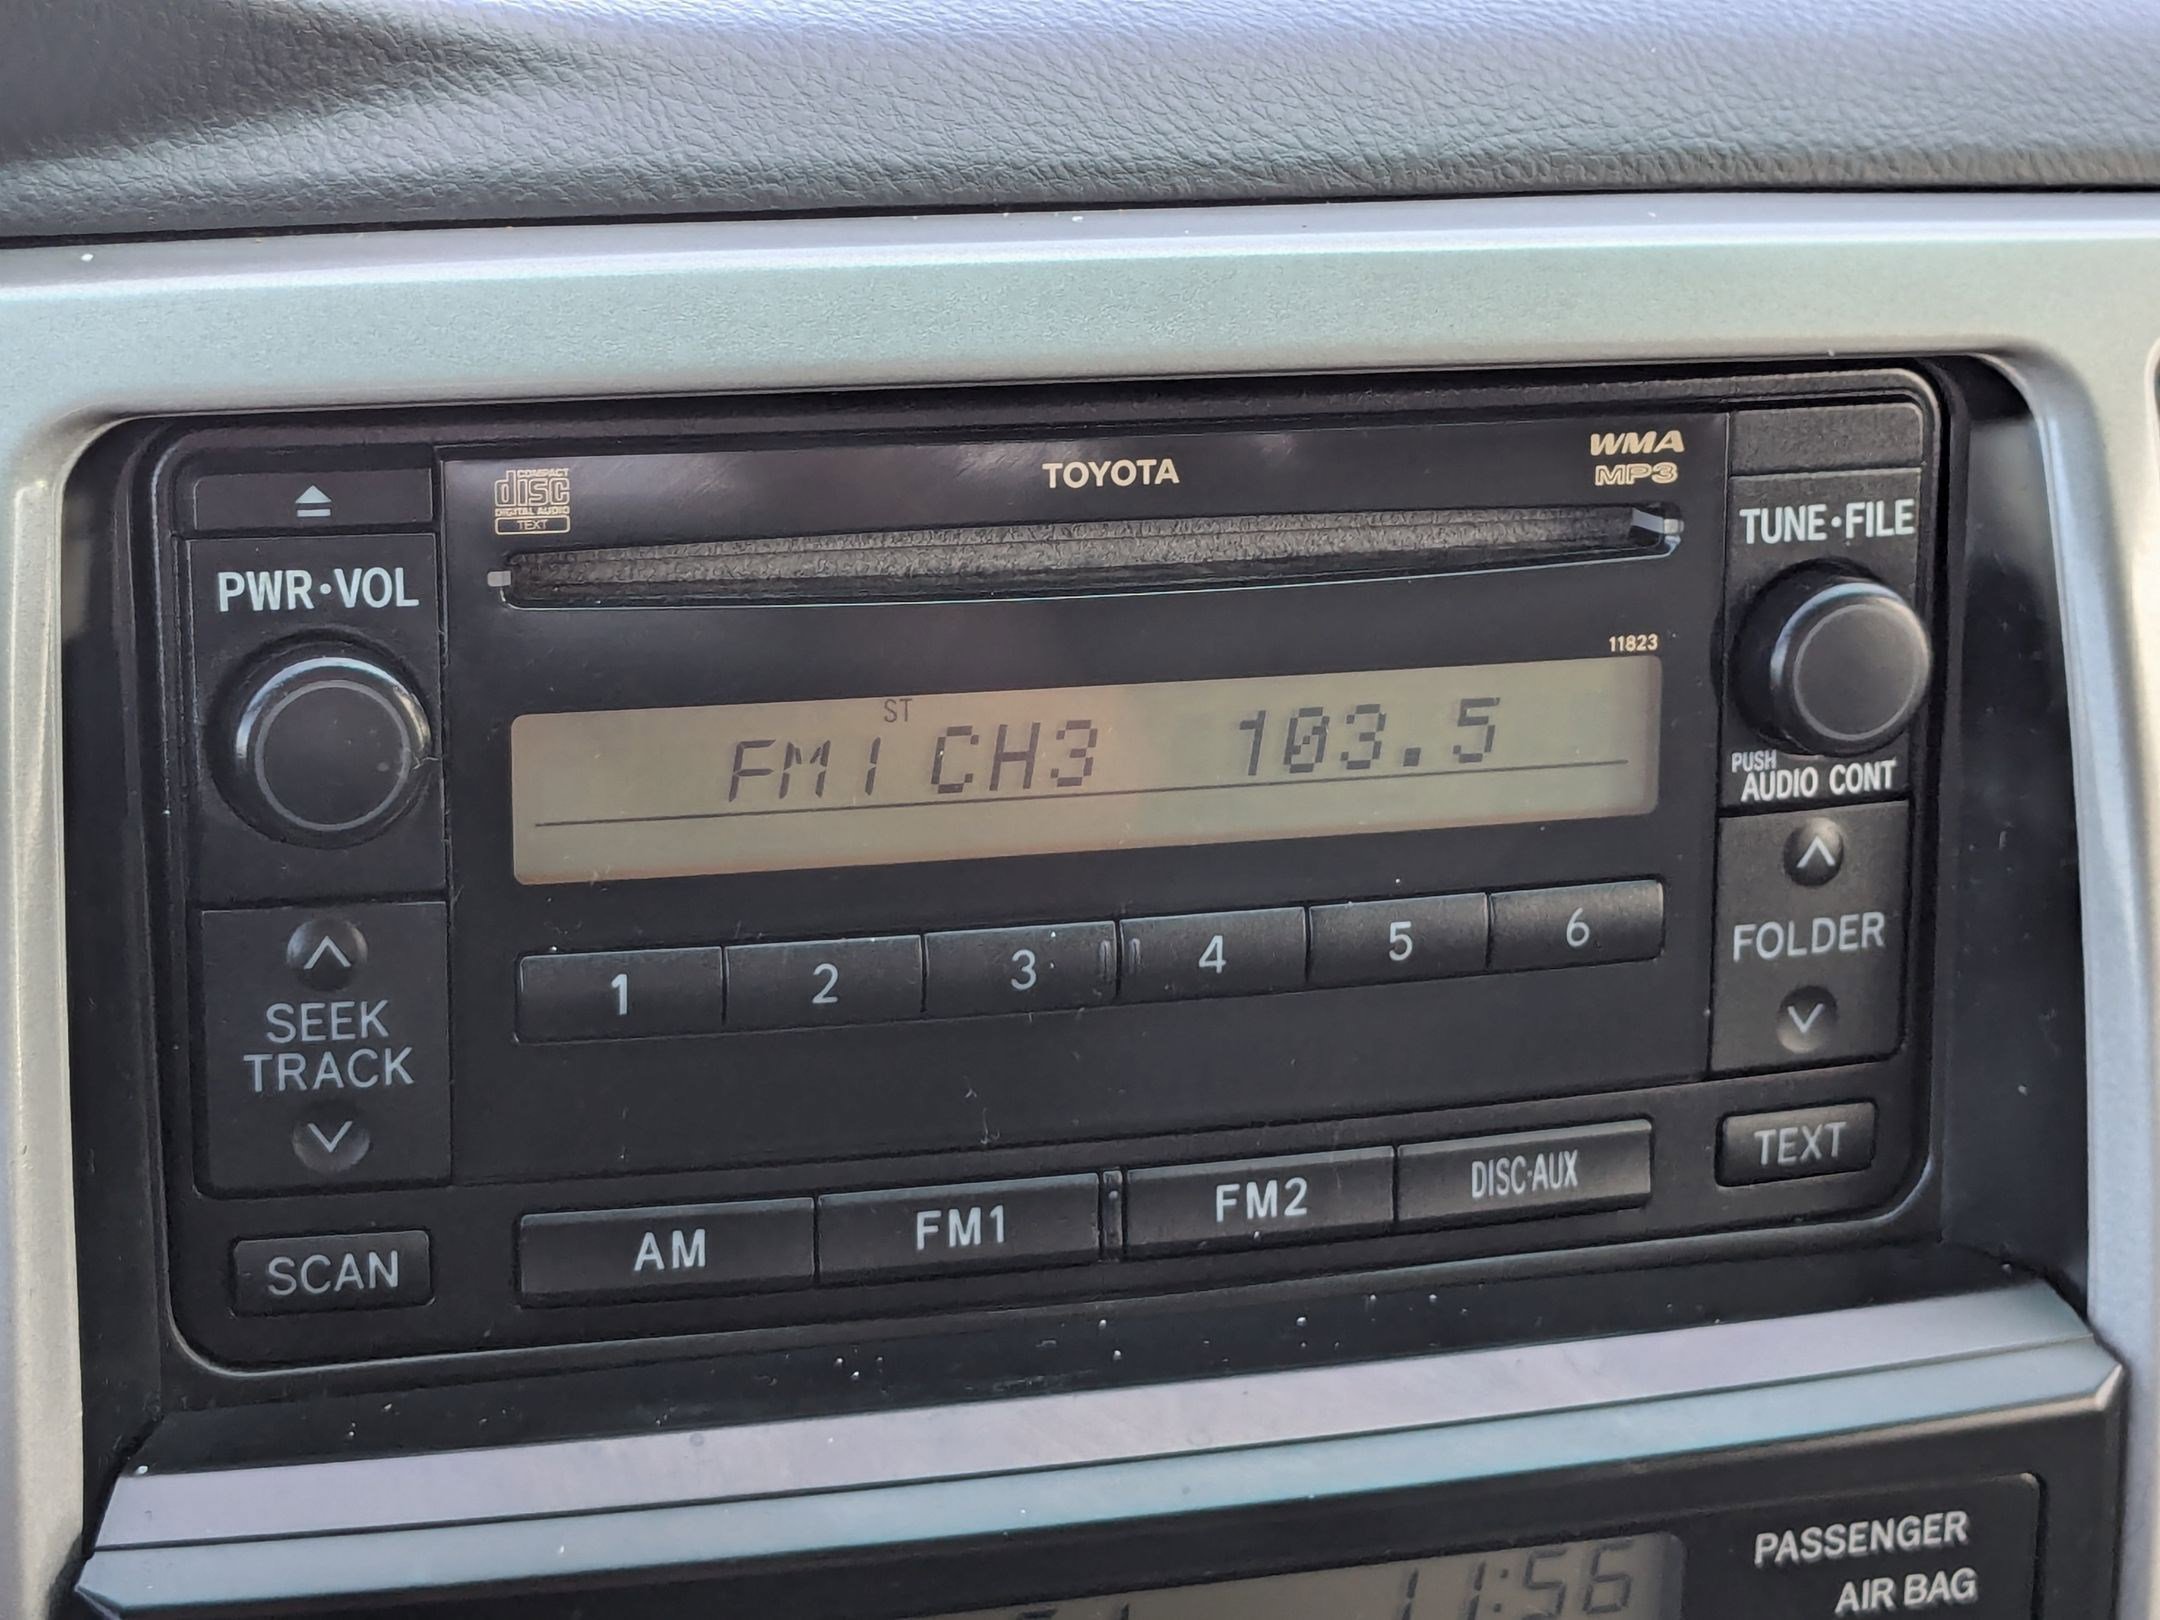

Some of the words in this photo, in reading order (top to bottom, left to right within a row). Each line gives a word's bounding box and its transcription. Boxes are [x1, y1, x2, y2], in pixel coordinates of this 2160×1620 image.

[1590, 430, 1685, 456] WMA
[1041, 458, 1181, 489] TOYOTA
[1594, 462, 1678, 486] MP3
[516, 519, 548, 530] TEXT
[537, 506, 570, 516] AUDIO
[1609, 634, 1659, 652] 11823
[883, 699, 912, 723] ST
[931, 719, 1098, 794] CH3
[1238, 697, 1500, 777] 103.5
[1731, 750, 1777, 773] PUSH
[1741, 767, 1819, 802] AUDIO
[1829, 757, 1897, 796] CONT
[1388, 921, 1413, 961] 5
[1566, 907, 1590, 947] 6
[1733, 911, 1885, 962] FOLDER
[1010, 949, 1036, 990] 3
[1199, 934, 1226, 974] 4
[610, 973, 628, 1015] 1
[812, 963, 838, 1004] 2
[266, 999, 389, 1044] SEEK
[243, 1046, 414, 1092] TRACK
[1754, 1121, 1847, 1165] TEXT
[1216, 1178, 1308, 1223] FM2
[916, 1205, 1006, 1250] FM1
[633, 1228, 707, 1271] AM
[268, 1250, 399, 1296] SCAN
[1754, 1510, 1968, 1567] PASSENGER
[1399, 1538, 1634, 1620] 11:56
[1834, 1580, 1896, 1615] AIR
[1904, 1567, 1977, 1606] BAG
